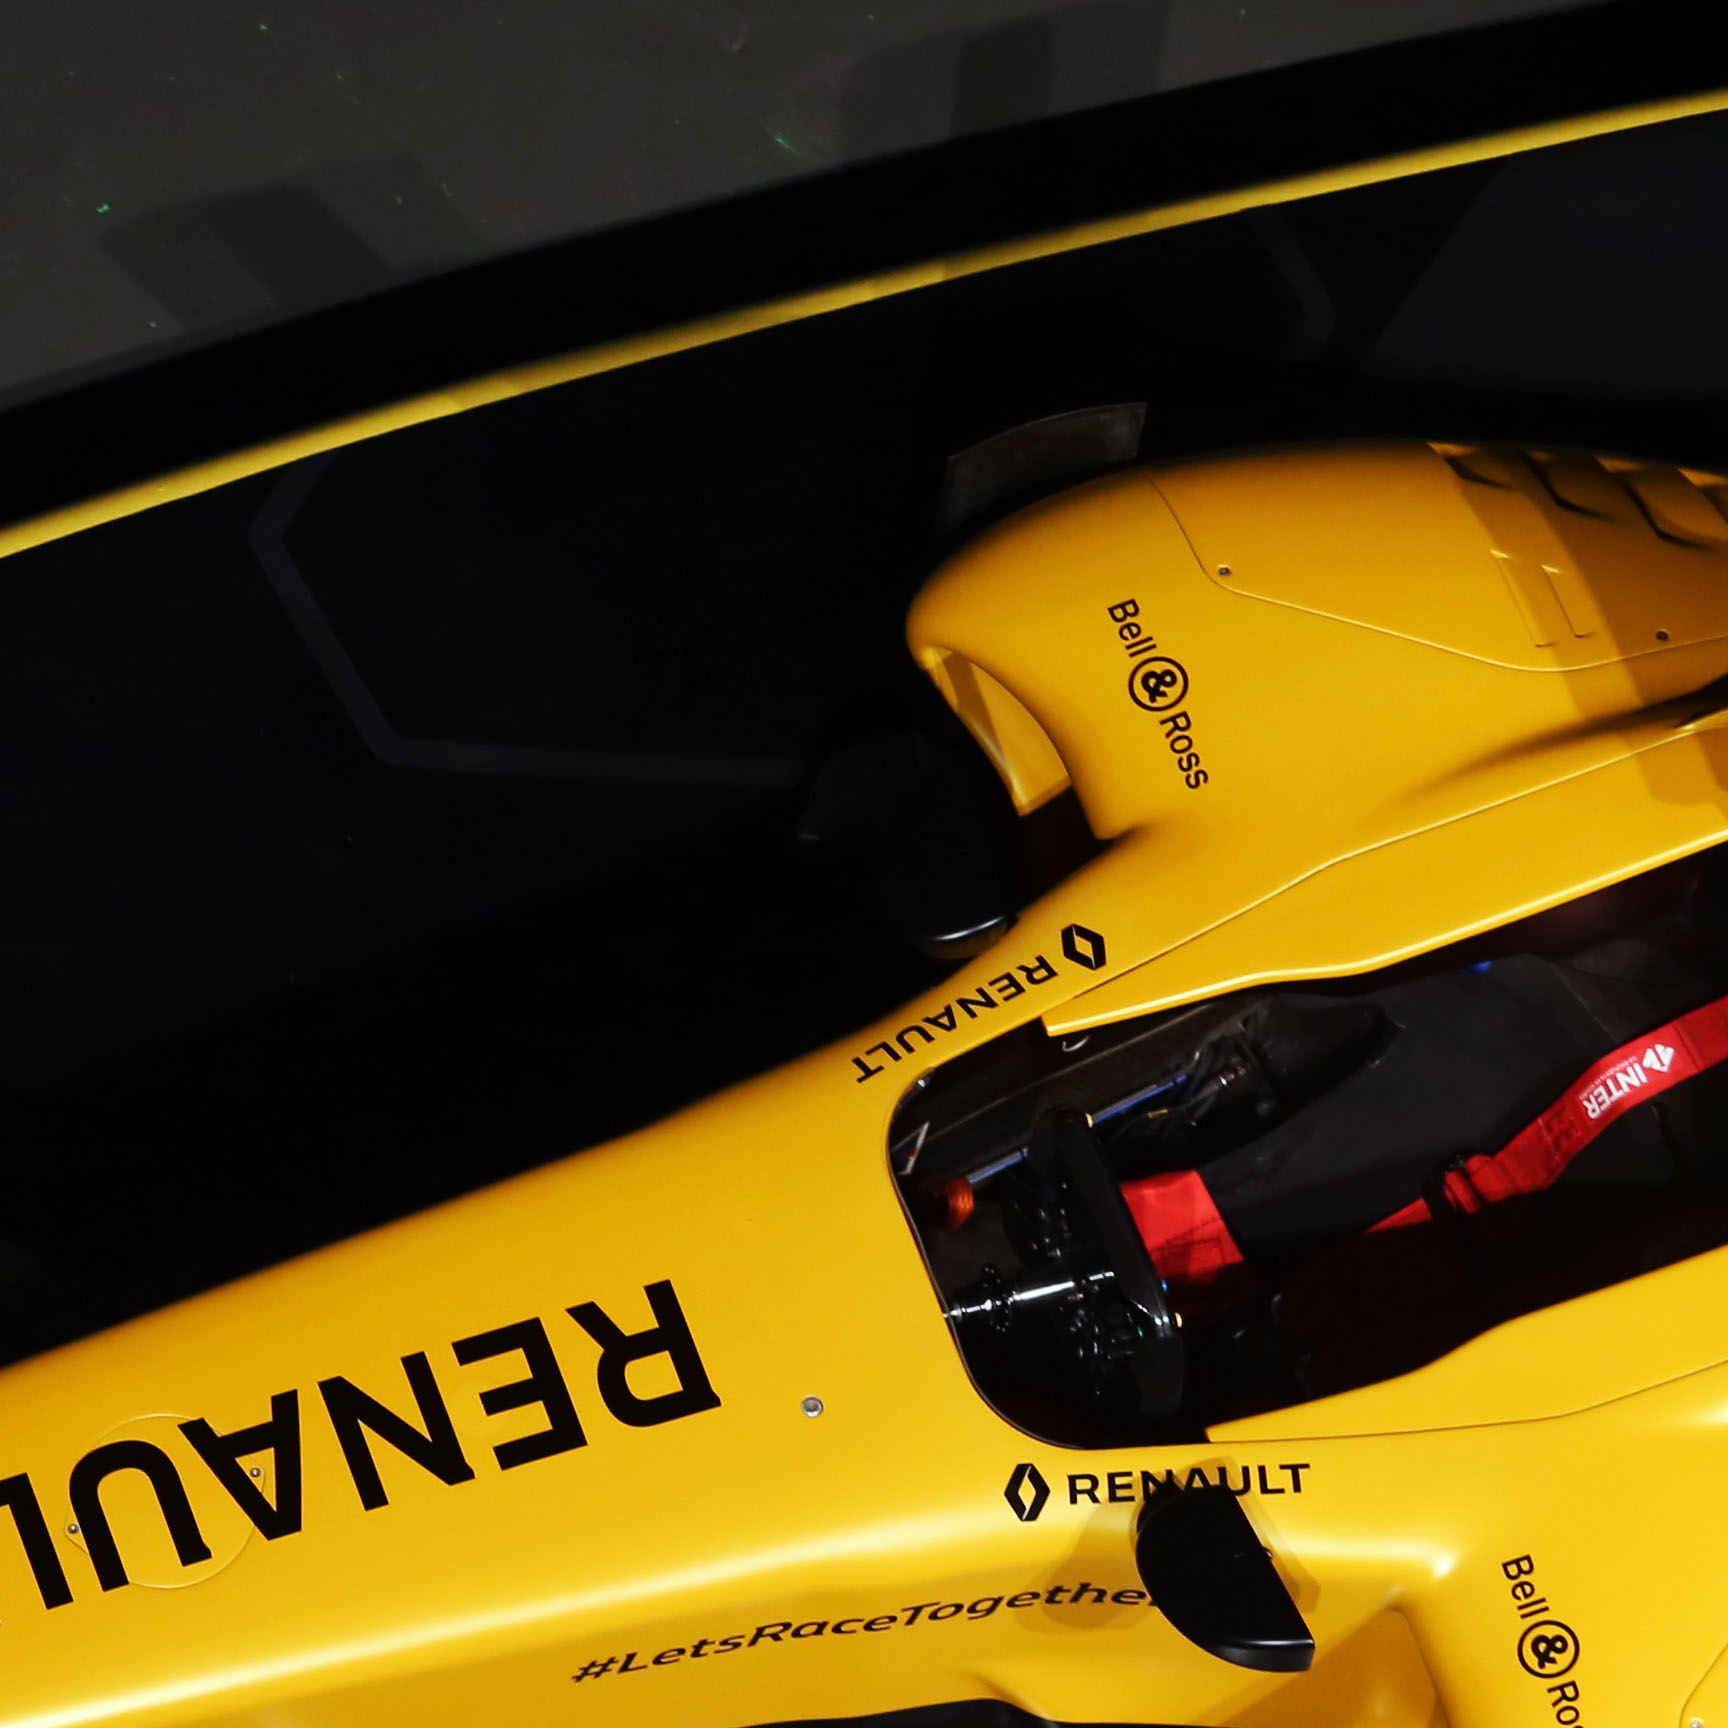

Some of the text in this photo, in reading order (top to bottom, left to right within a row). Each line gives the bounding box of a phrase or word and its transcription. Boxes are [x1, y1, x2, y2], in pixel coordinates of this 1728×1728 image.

[1107, 598, 1158, 660] Bell
[1157, 710, 1209, 790] Ross
[851, 954, 1059, 1083] RENAULT
[1582, 1063, 1648, 1119] INTER
[1067, 1463, 1310, 1504] RENAULT
[1500, 1554, 1550, 1620] Bell
[571, 1582, 1157, 1685] #LetsRaceTogethe
